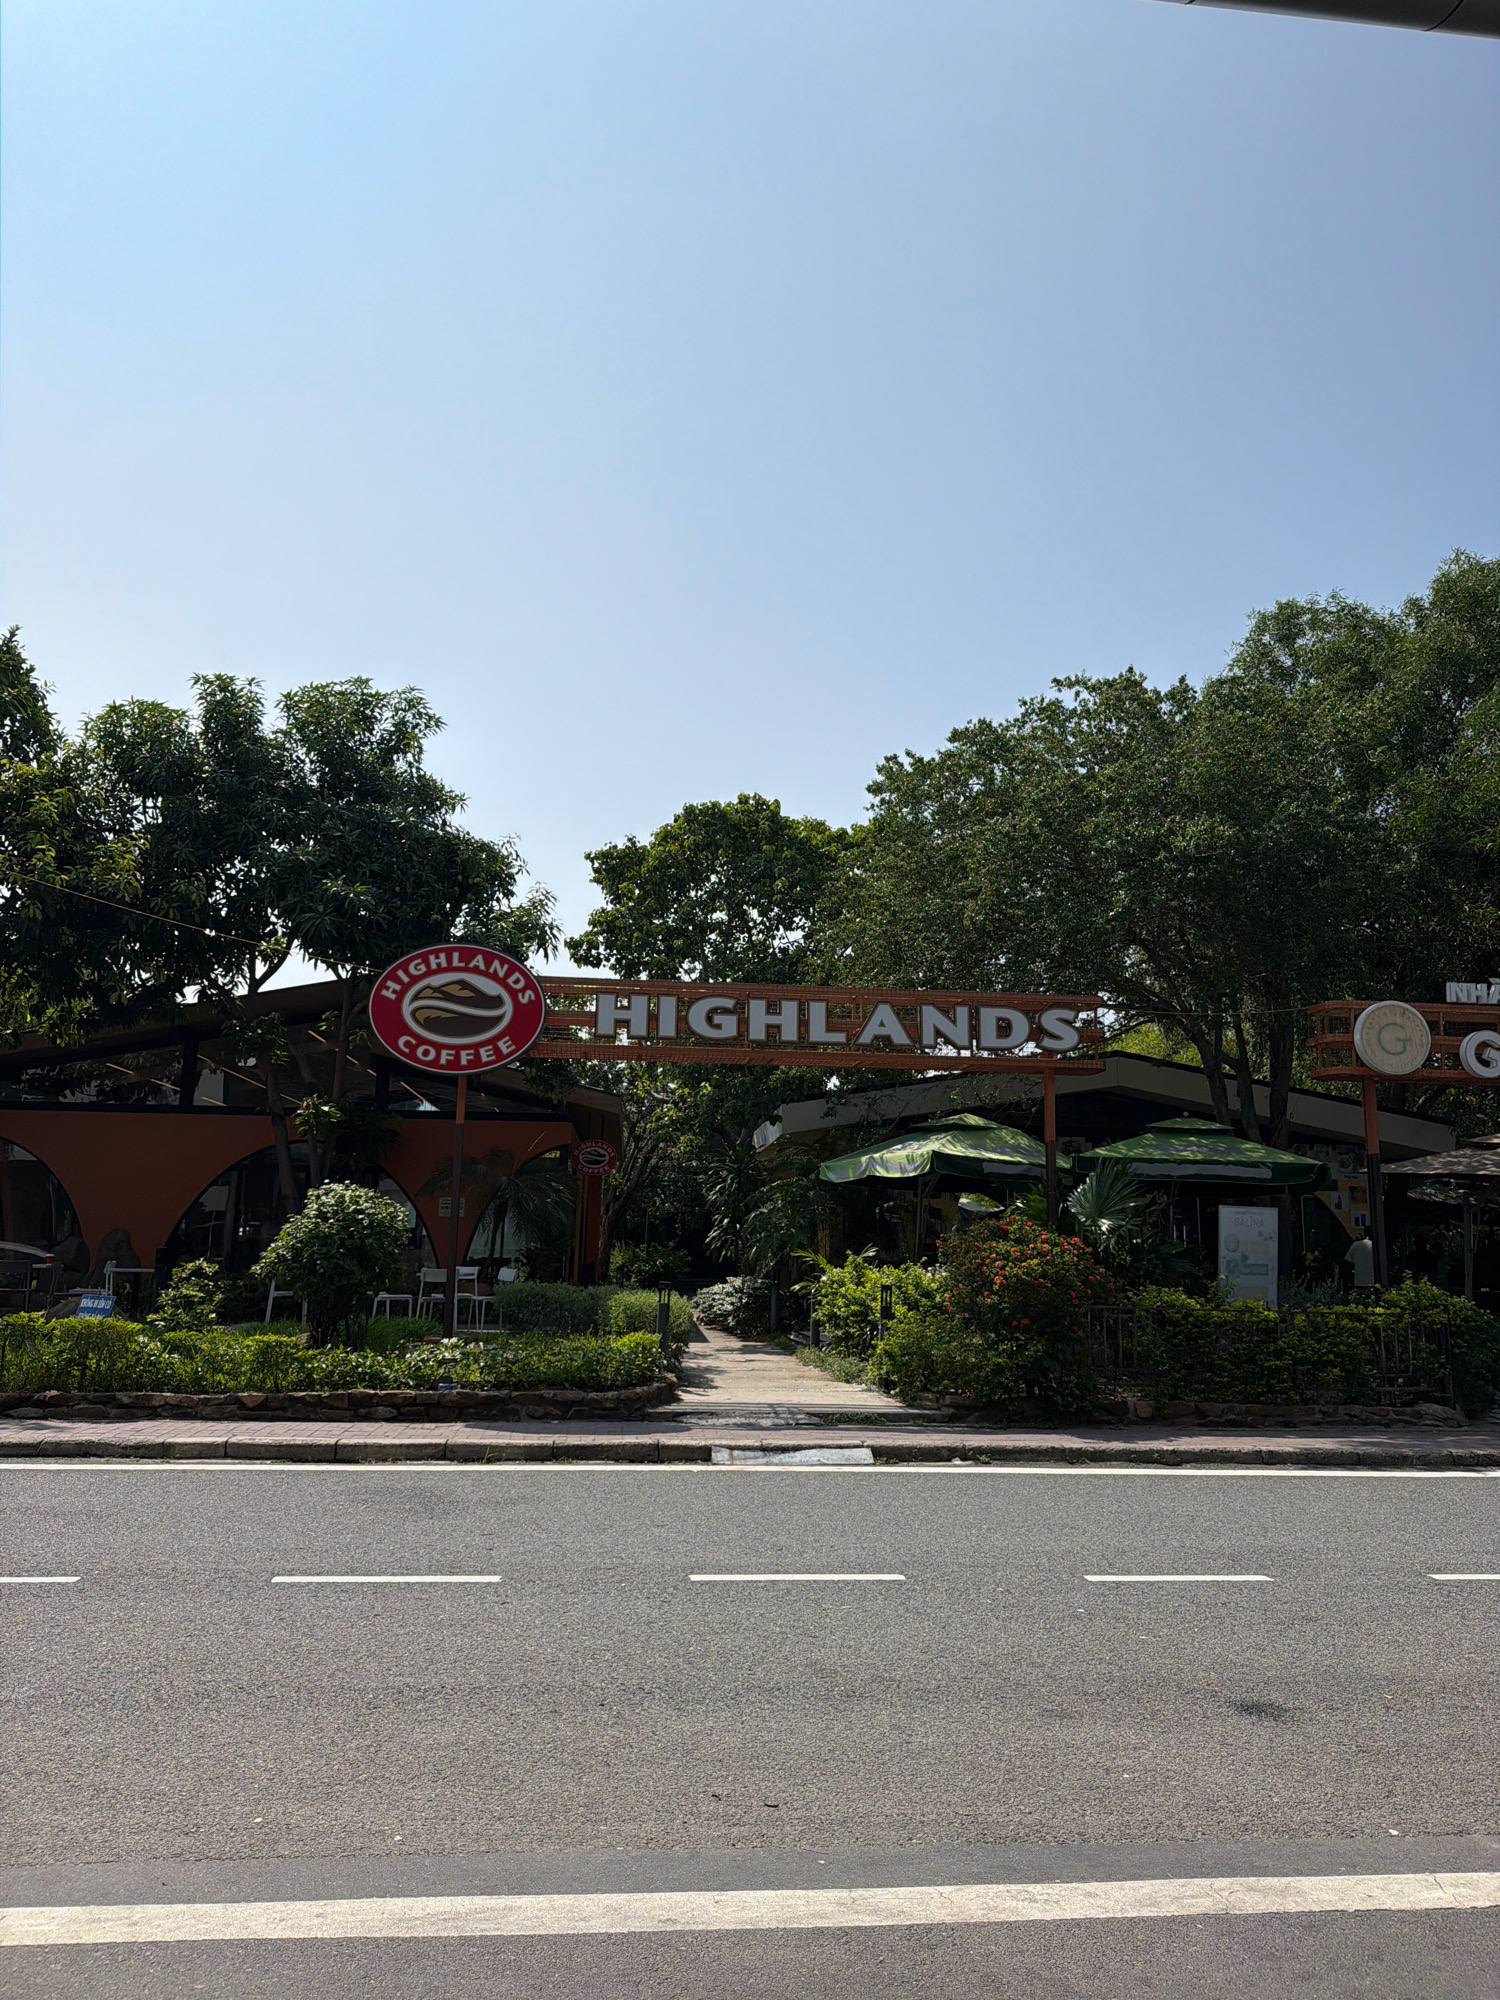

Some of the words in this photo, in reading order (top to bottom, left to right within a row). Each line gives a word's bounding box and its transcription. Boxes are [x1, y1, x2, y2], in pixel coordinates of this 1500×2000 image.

[381, 951, 536, 1005] HIGHLANDS
[596, 992, 1082, 1052] HIGHLANDS
[397, 1035, 516, 1066] COFFEE
[1377, 1023, 1411, 1056] G
[573, 1141, 616, 1157] HIGHLANDS
[577, 1164, 610, 1174] COFFEE
